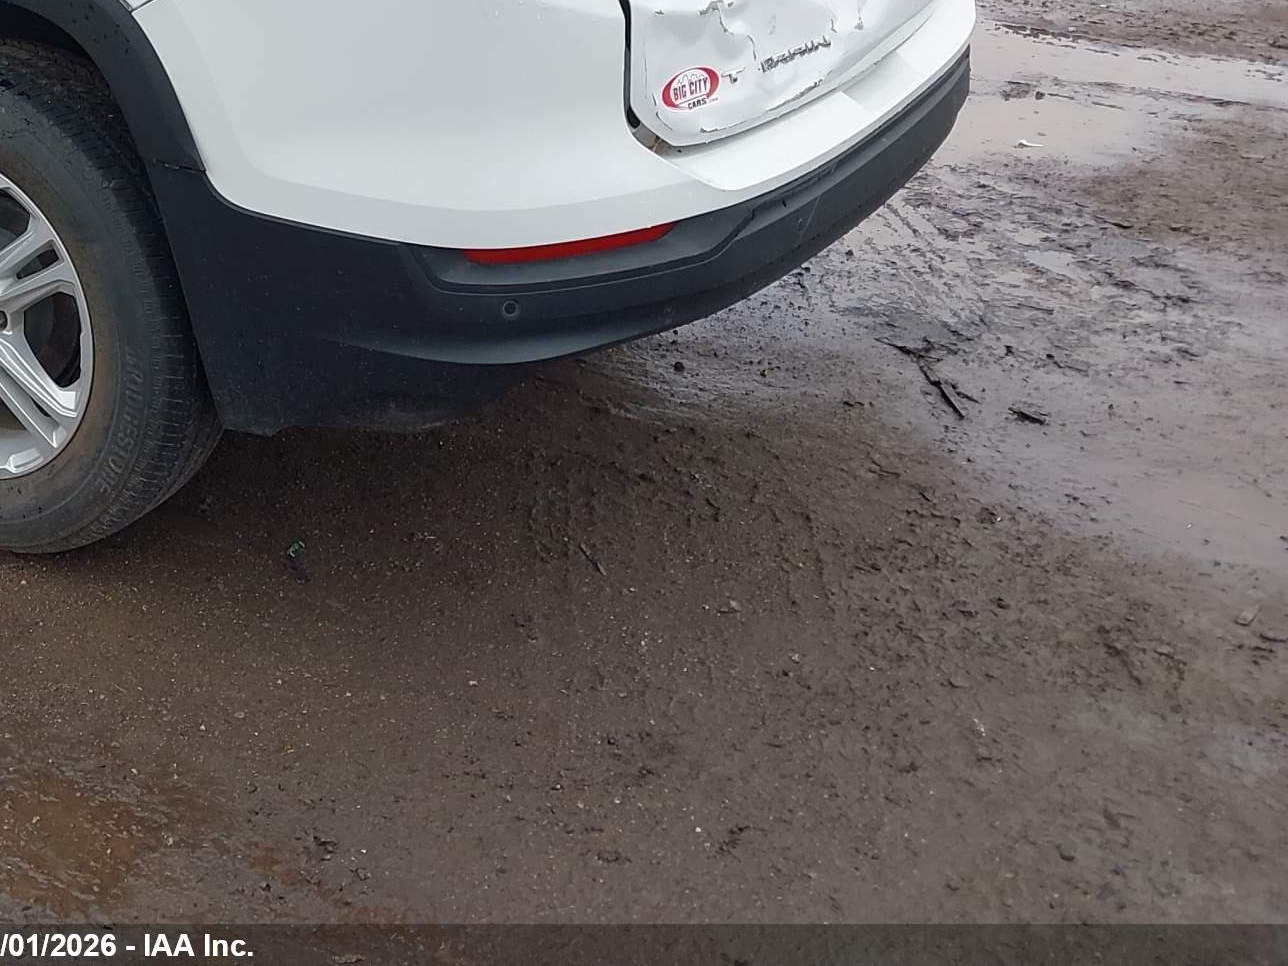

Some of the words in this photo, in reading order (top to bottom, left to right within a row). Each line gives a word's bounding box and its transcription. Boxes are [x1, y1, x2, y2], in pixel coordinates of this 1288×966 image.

[673, 84, 687, 102] BIG
[689, 77, 708, 95] CITY
[687, 97, 708, 111] CARS
